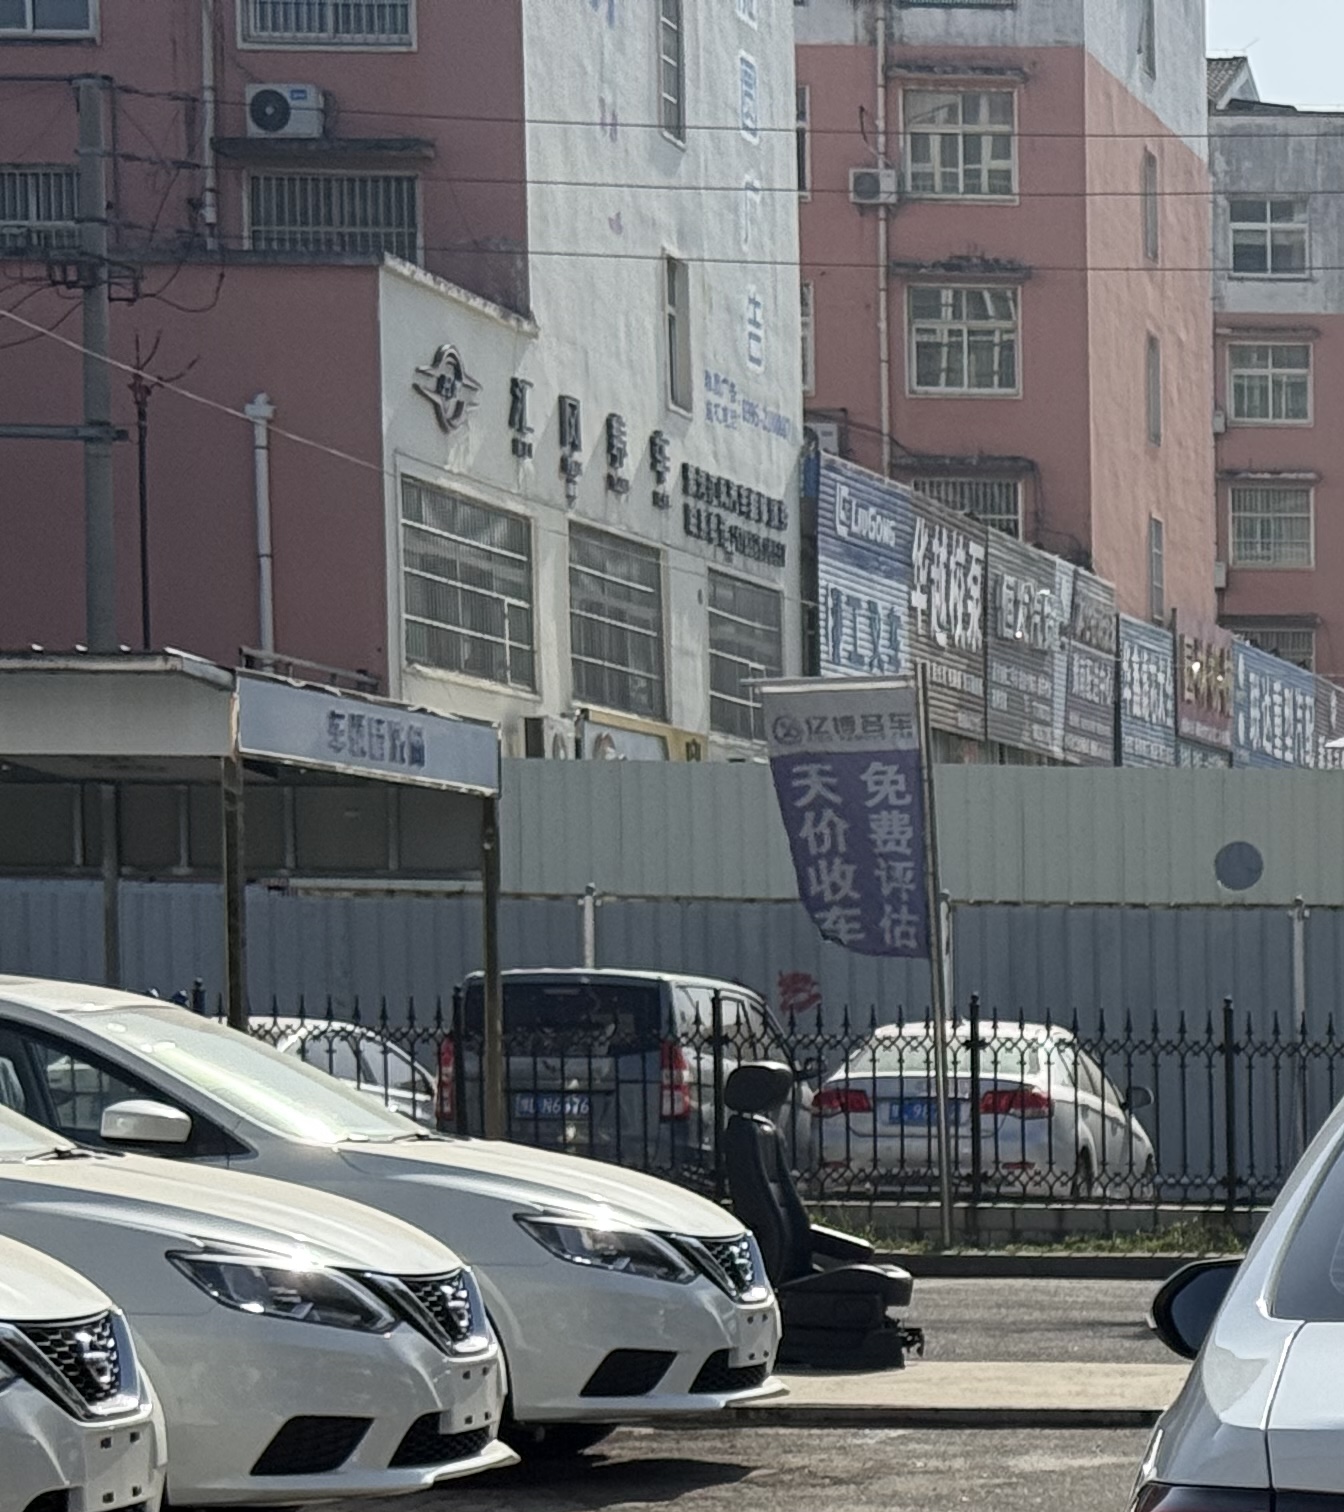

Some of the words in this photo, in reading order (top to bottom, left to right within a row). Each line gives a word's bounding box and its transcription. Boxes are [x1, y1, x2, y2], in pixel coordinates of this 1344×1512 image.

[790, 762, 866, 946] 天价收车
[860, 760, 922, 949] 免费评估
